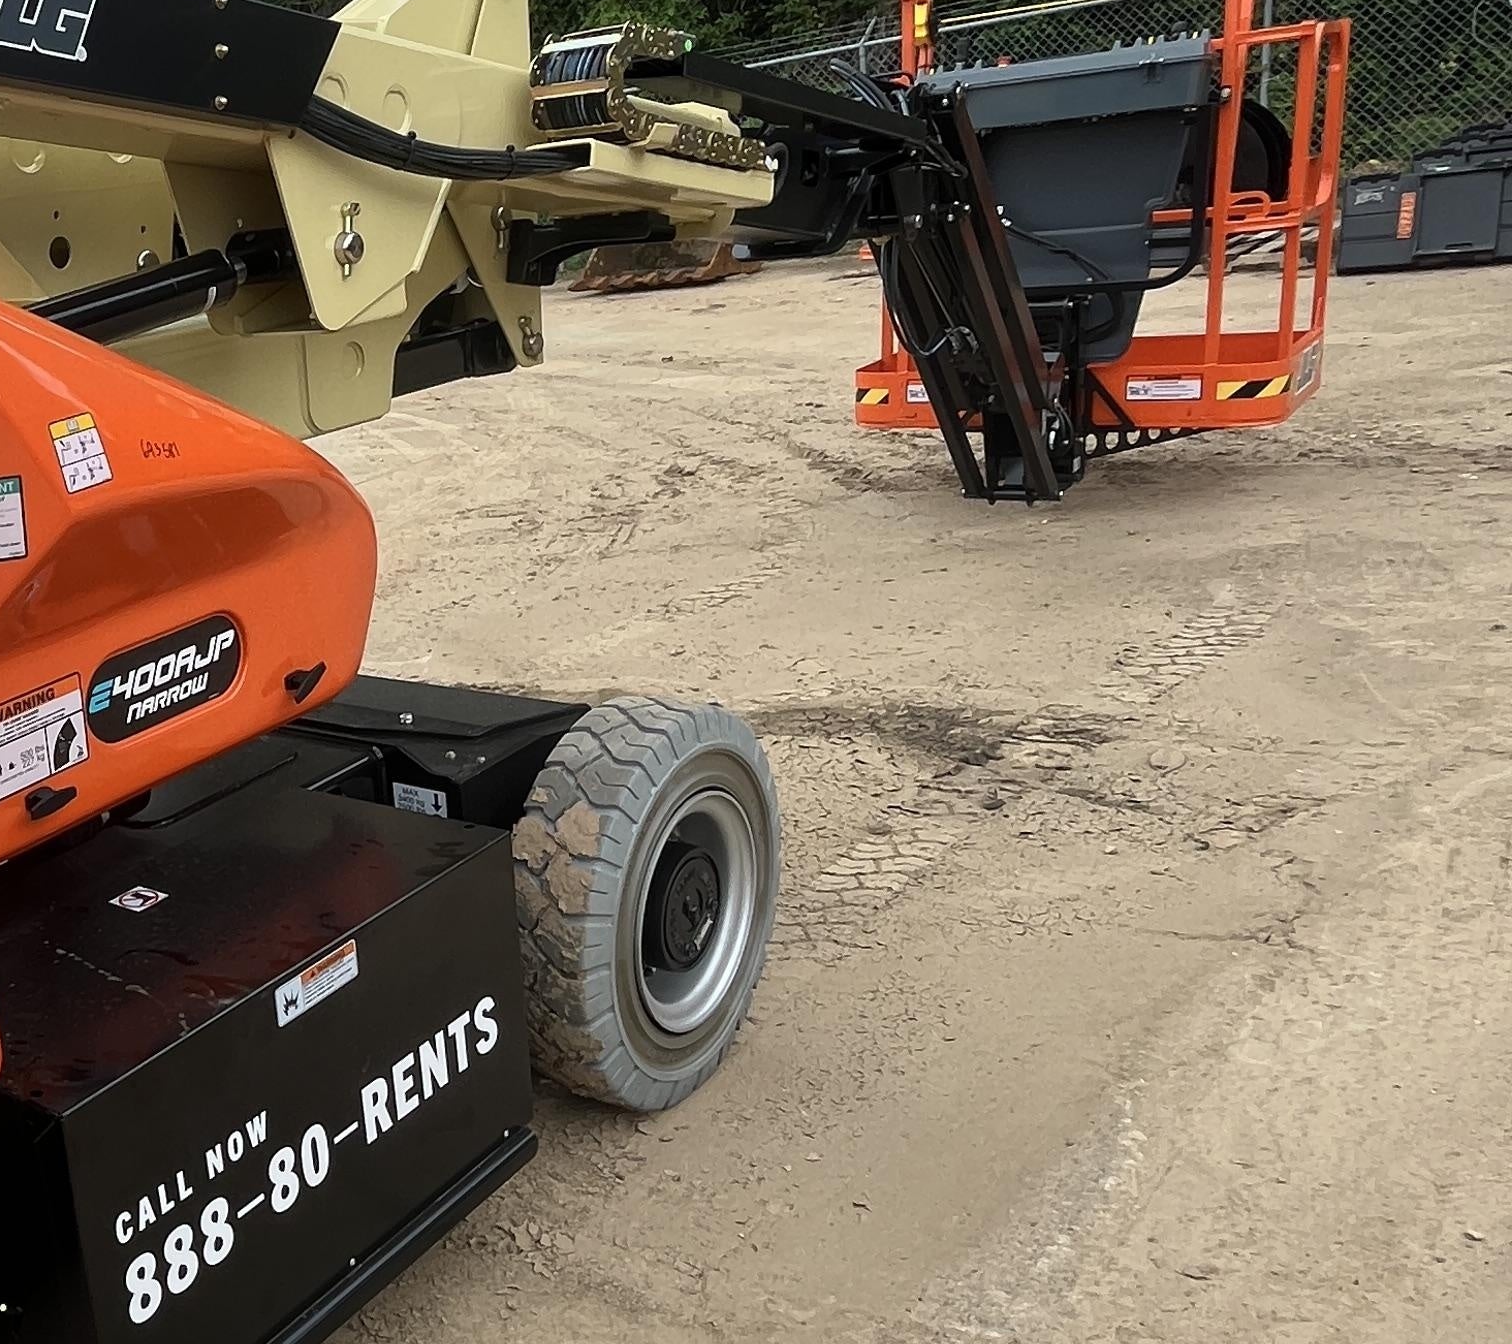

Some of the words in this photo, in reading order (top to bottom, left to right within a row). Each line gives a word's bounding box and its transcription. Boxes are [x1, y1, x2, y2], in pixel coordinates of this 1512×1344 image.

[89, 628, 236, 714] E400AJP
[126, 672, 209, 724] NARROW
[115, 1170, 194, 1244] CALL
[205, 1110, 269, 1180] NOW
[125, 996, 499, 1325] 888-80-RENTS
